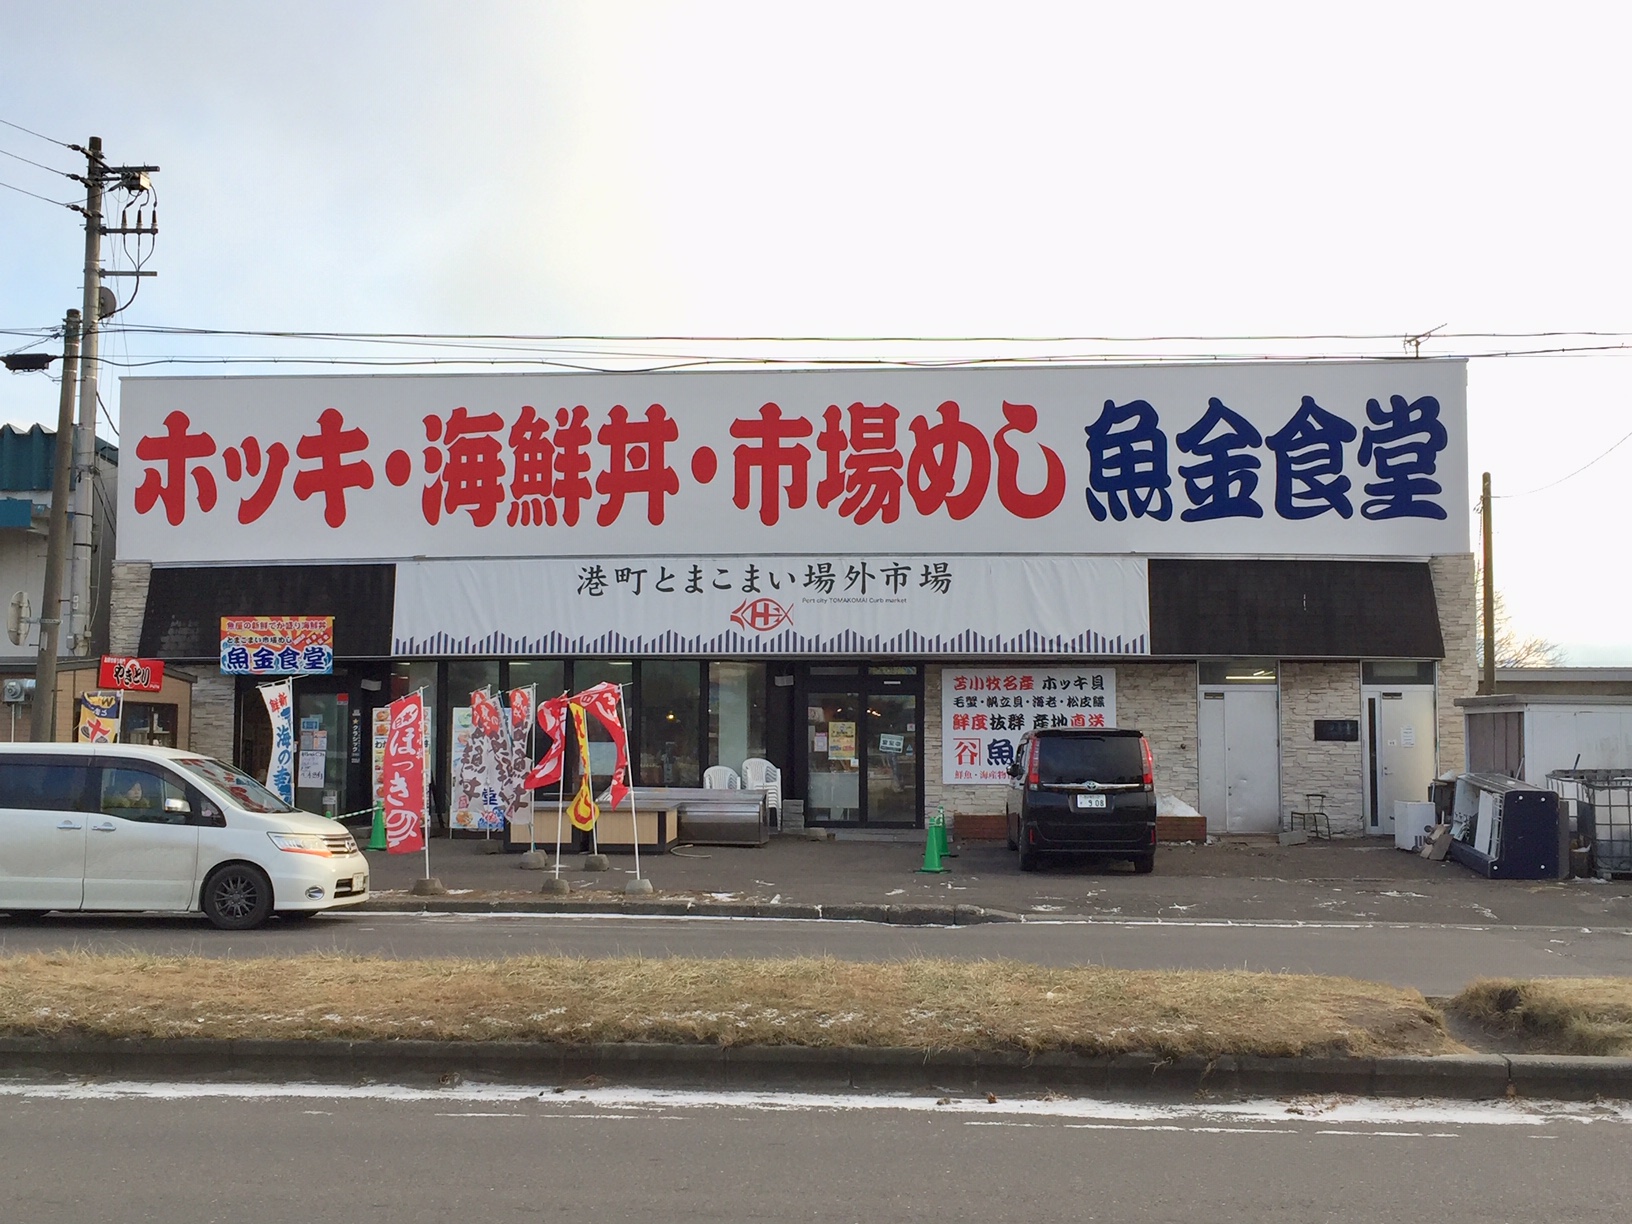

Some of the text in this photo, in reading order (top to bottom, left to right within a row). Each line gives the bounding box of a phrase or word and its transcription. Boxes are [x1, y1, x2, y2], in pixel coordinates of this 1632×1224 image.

[134, 395, 1448, 528] ホッキ・海鮮丼・市場めし 魚金食堂
[577, 562, 953, 596] 港町とまこまい場外市場
[816, 597, 828, 605] city
[226, 646, 326, 670] 魚金食堂
[113, 662, 150, 688] やきとり
[953, 674, 1105, 691] 苫小牧名産 ホッキ貝
[952, 713, 1105, 731] 鮮度抜群 産地直送
